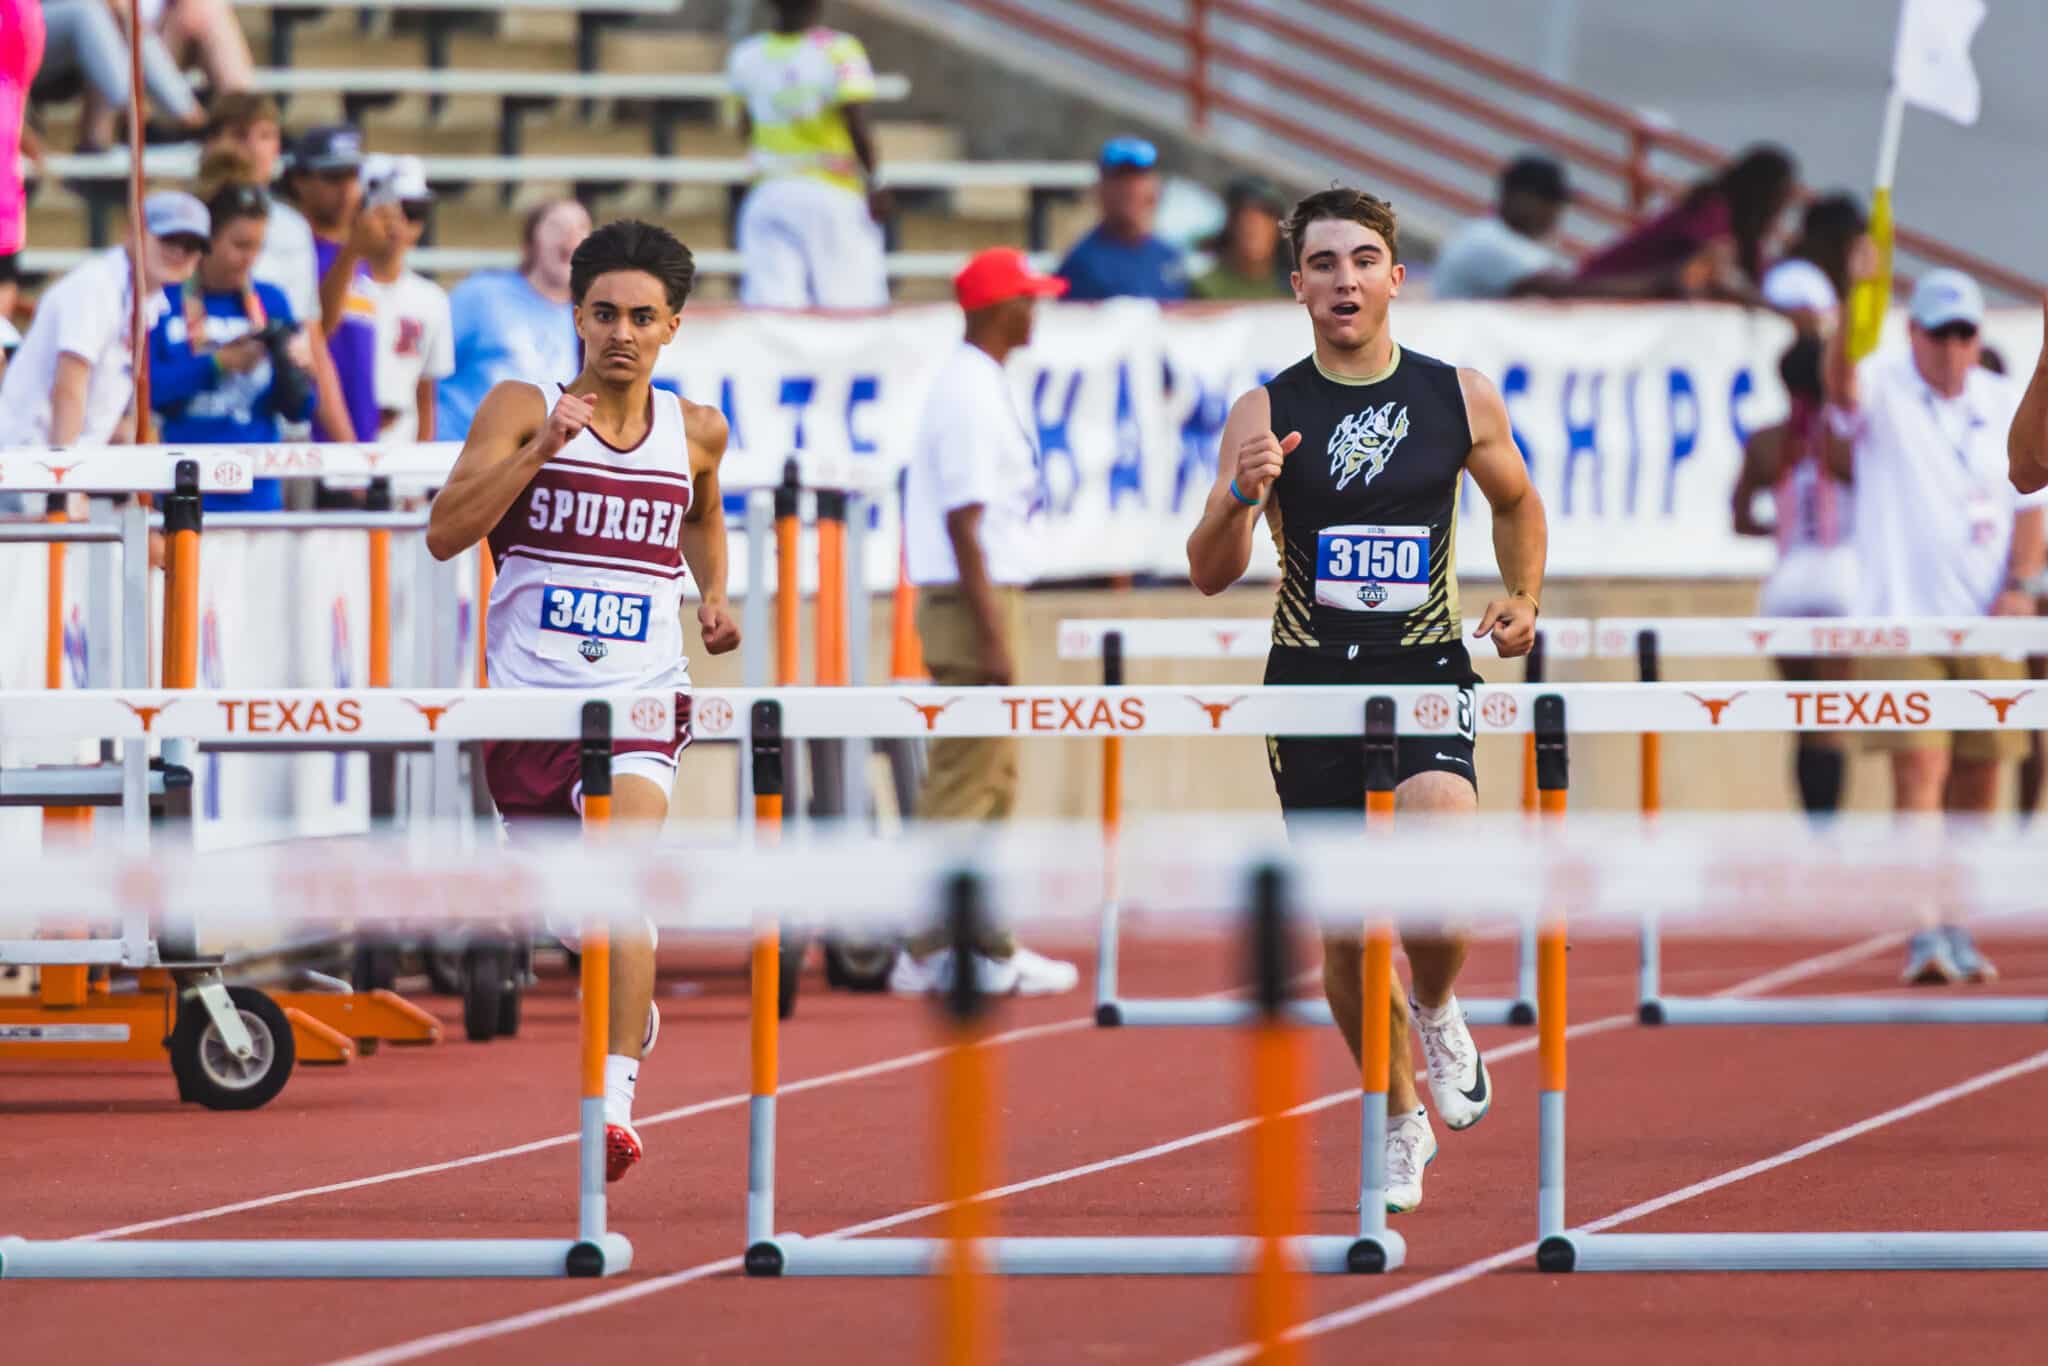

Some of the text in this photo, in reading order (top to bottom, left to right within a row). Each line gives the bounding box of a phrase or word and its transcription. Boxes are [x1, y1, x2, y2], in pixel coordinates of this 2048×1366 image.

[1328, 538, 1420, 579] 3150
[1357, 590, 1388, 600] STATE
[550, 588, 644, 637] 3485
[1810, 627, 1910, 650] TEXAS
[217, 699, 362, 733] TEXAS
[1001, 697, 1146, 731] TEXAS
[1786, 691, 1931, 725] TEXAS
